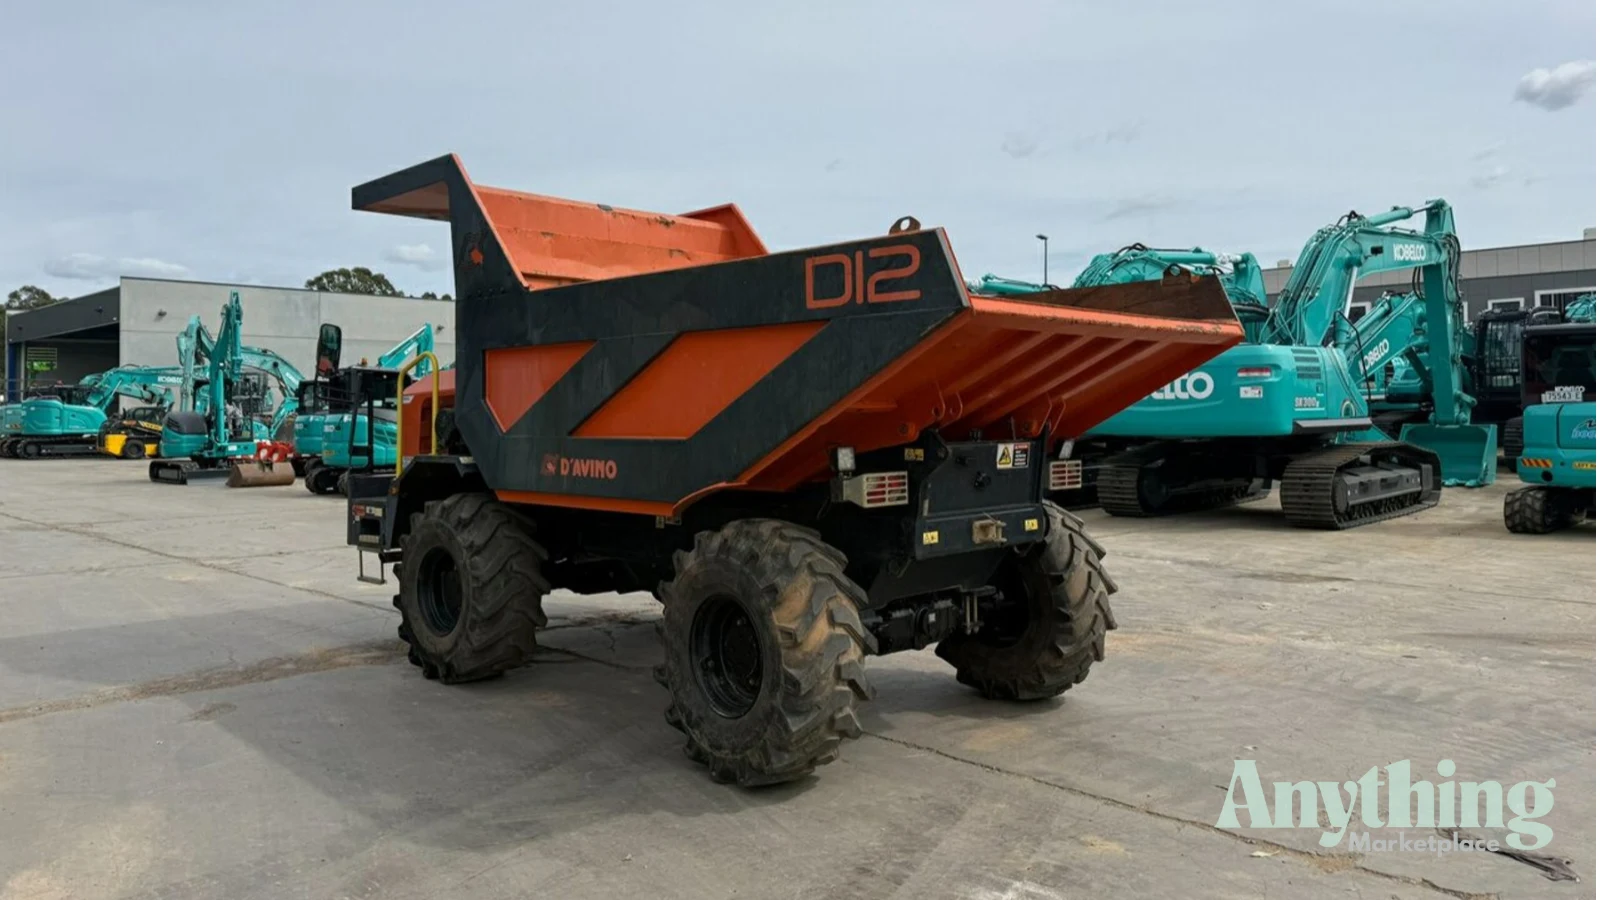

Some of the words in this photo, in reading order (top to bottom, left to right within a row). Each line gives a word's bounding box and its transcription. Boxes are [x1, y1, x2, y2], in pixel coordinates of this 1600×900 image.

[1393, 243, 1426, 261] KOBELCO
[805, 244, 921, 310] D12
[560, 457, 617, 479] D'AVINO
